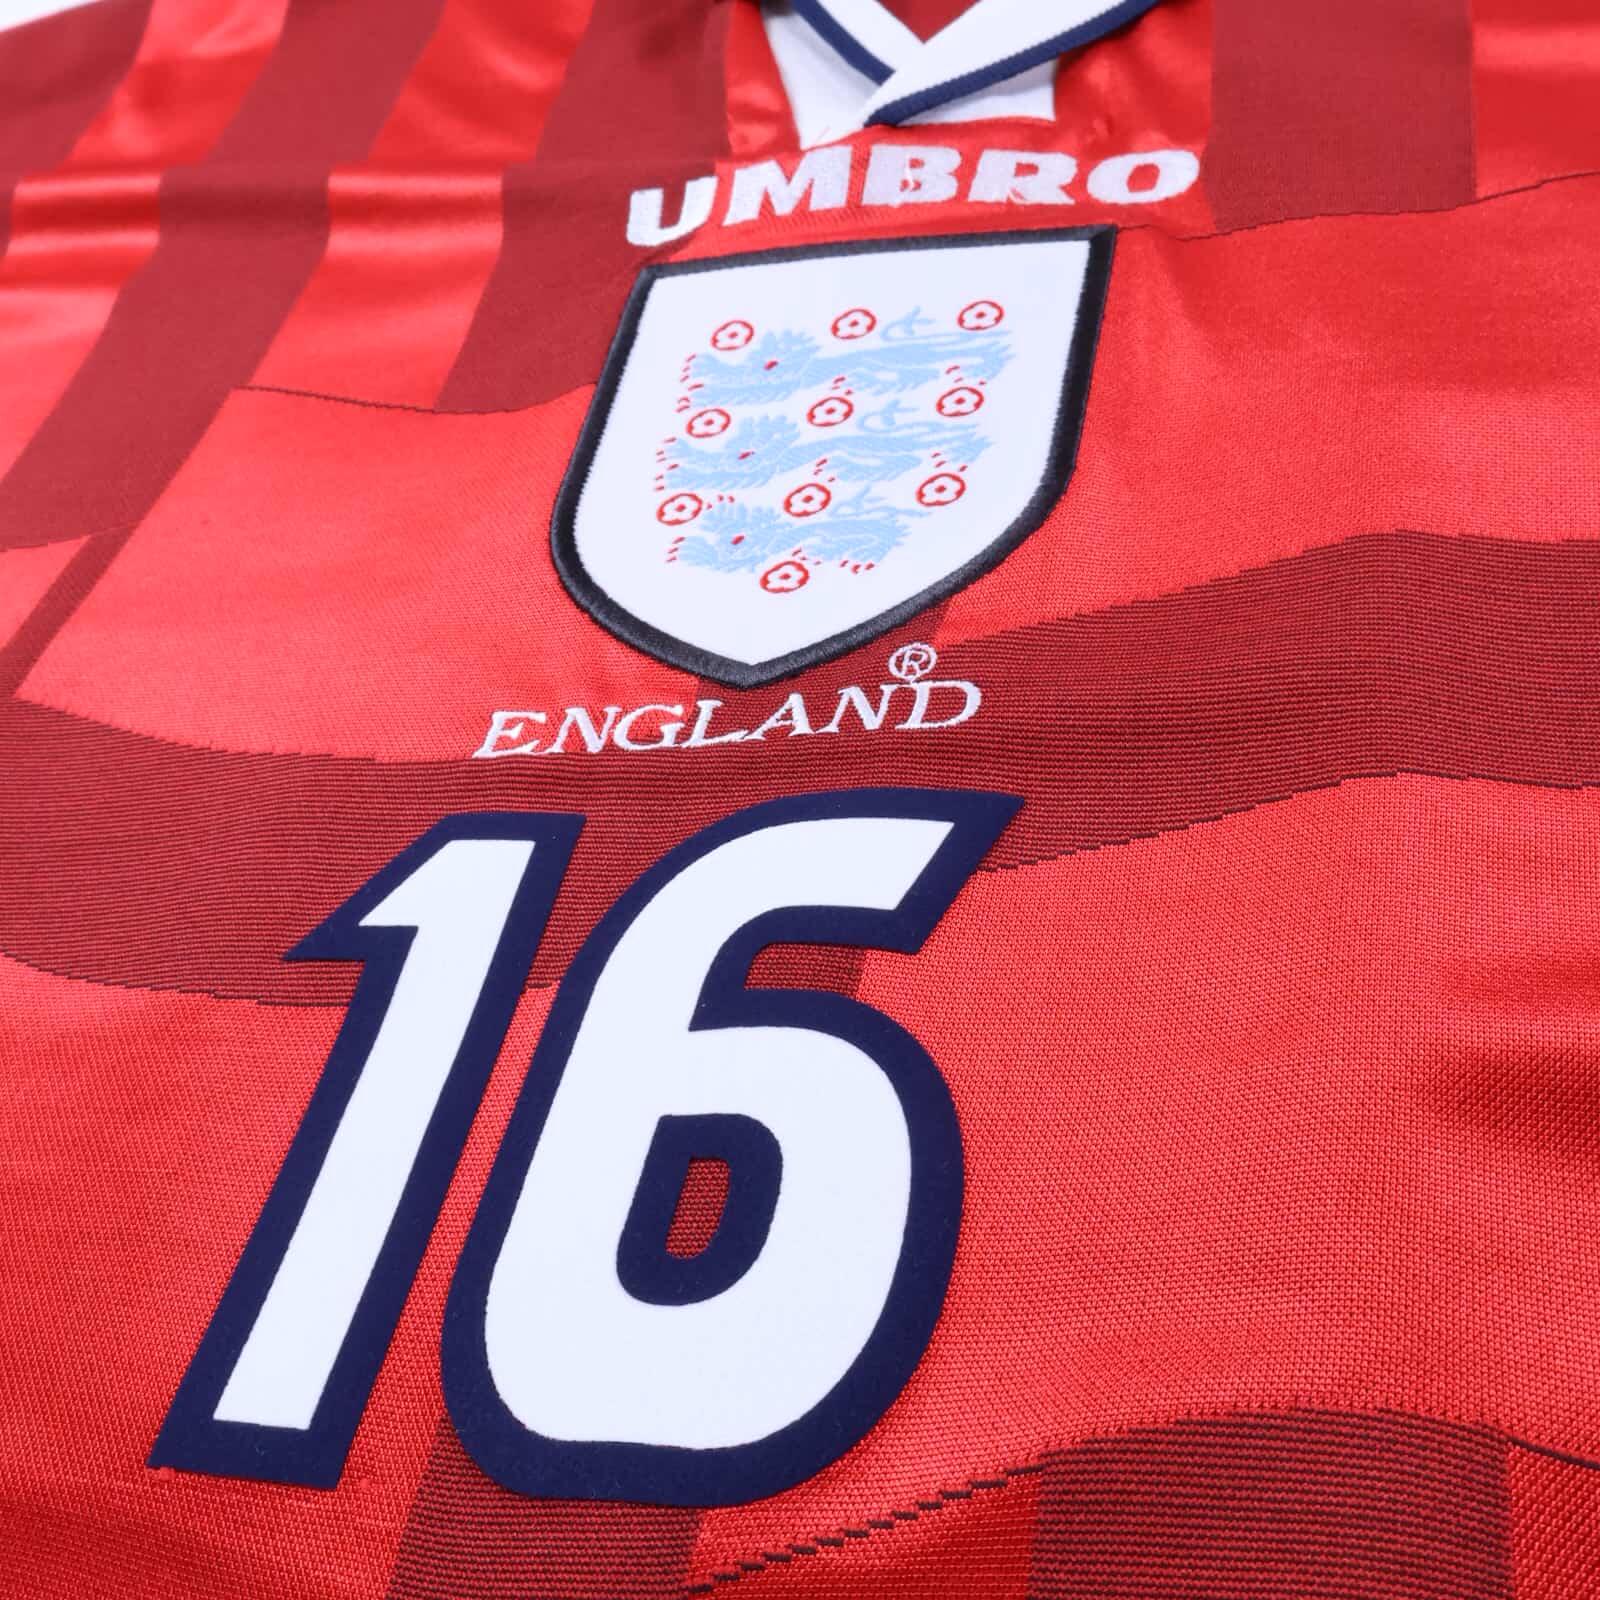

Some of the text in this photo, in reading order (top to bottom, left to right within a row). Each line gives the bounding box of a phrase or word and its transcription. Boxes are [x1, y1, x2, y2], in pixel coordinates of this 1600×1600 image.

[626, 144, 1199, 247] UMBRO
[471, 679, 982, 759] ENGLAND
[148, 786, 1025, 1508] 16
